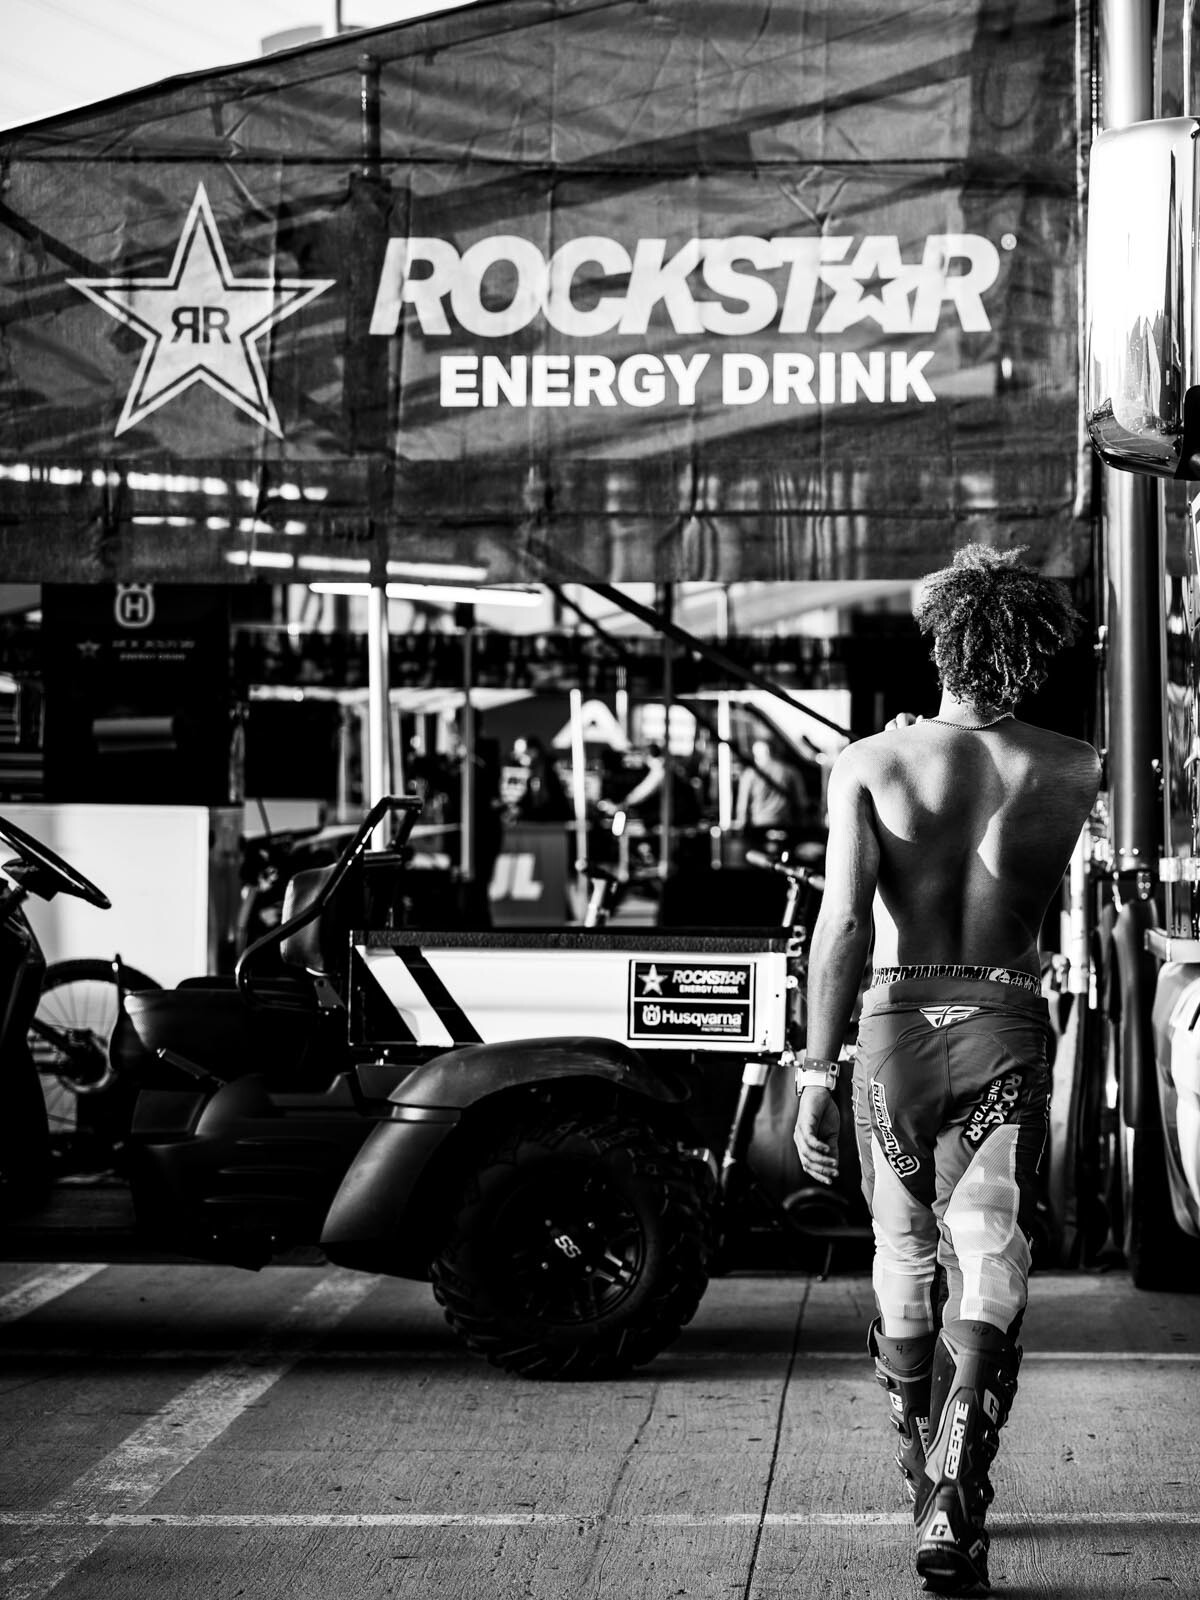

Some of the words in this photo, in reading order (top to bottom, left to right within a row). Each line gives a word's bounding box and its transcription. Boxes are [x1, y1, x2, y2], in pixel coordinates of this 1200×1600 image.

[369, 235, 1000, 337] ROCKSTAR
[440, 354, 711, 407] ENERGY
[722, 350, 936, 405] DRINK
[672, 969, 747, 985] ROCKSTAR
[662, 1009, 742, 1027] Husqvarna
